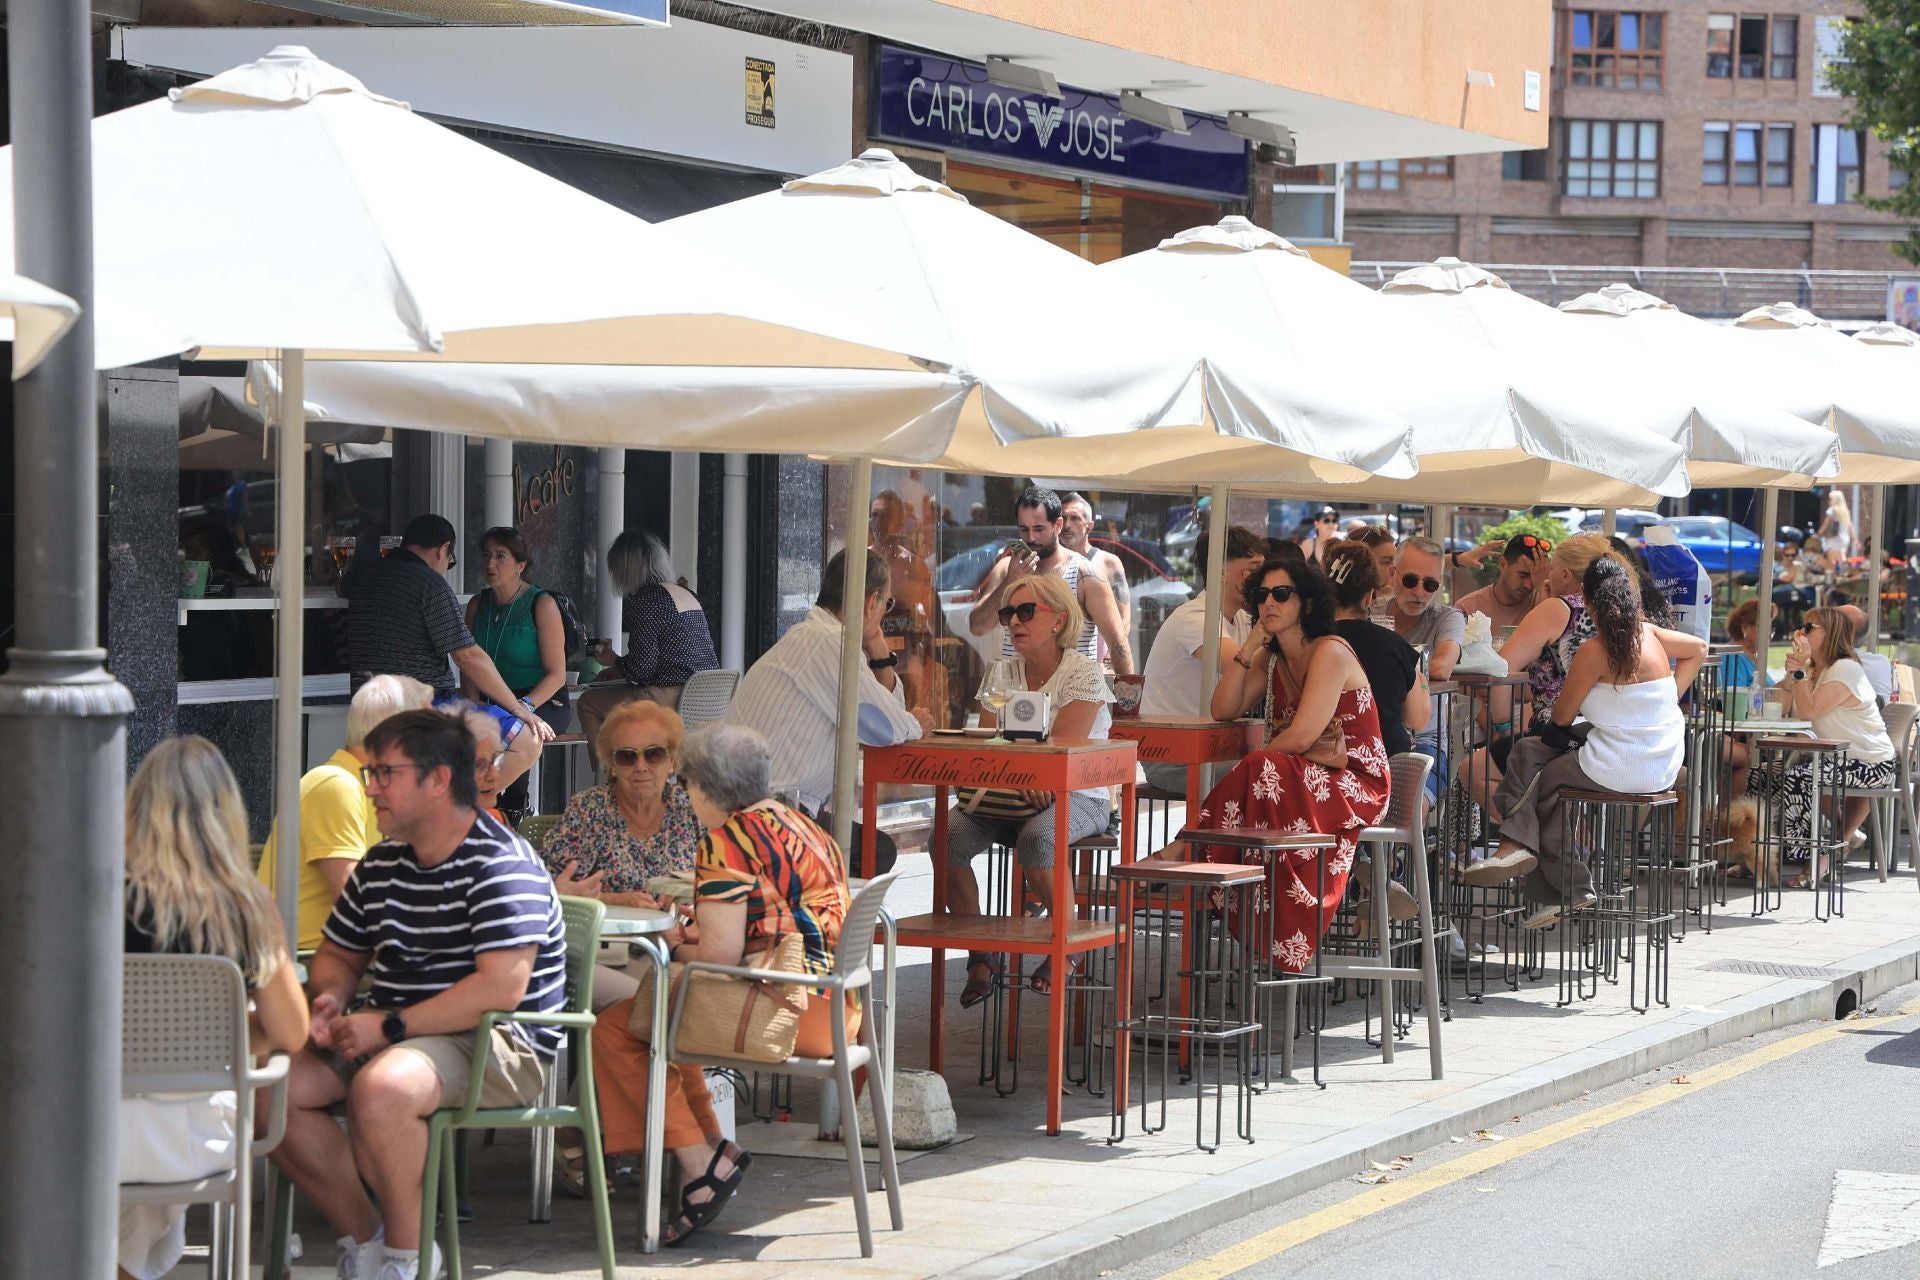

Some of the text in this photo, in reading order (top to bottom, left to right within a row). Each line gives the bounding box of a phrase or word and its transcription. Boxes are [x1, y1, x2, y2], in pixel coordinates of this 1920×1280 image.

[745, 59, 775, 73] CONECTADA
[907, 76, 1021, 144] CARLOS
[746, 113, 775, 128] PROSEGUR
